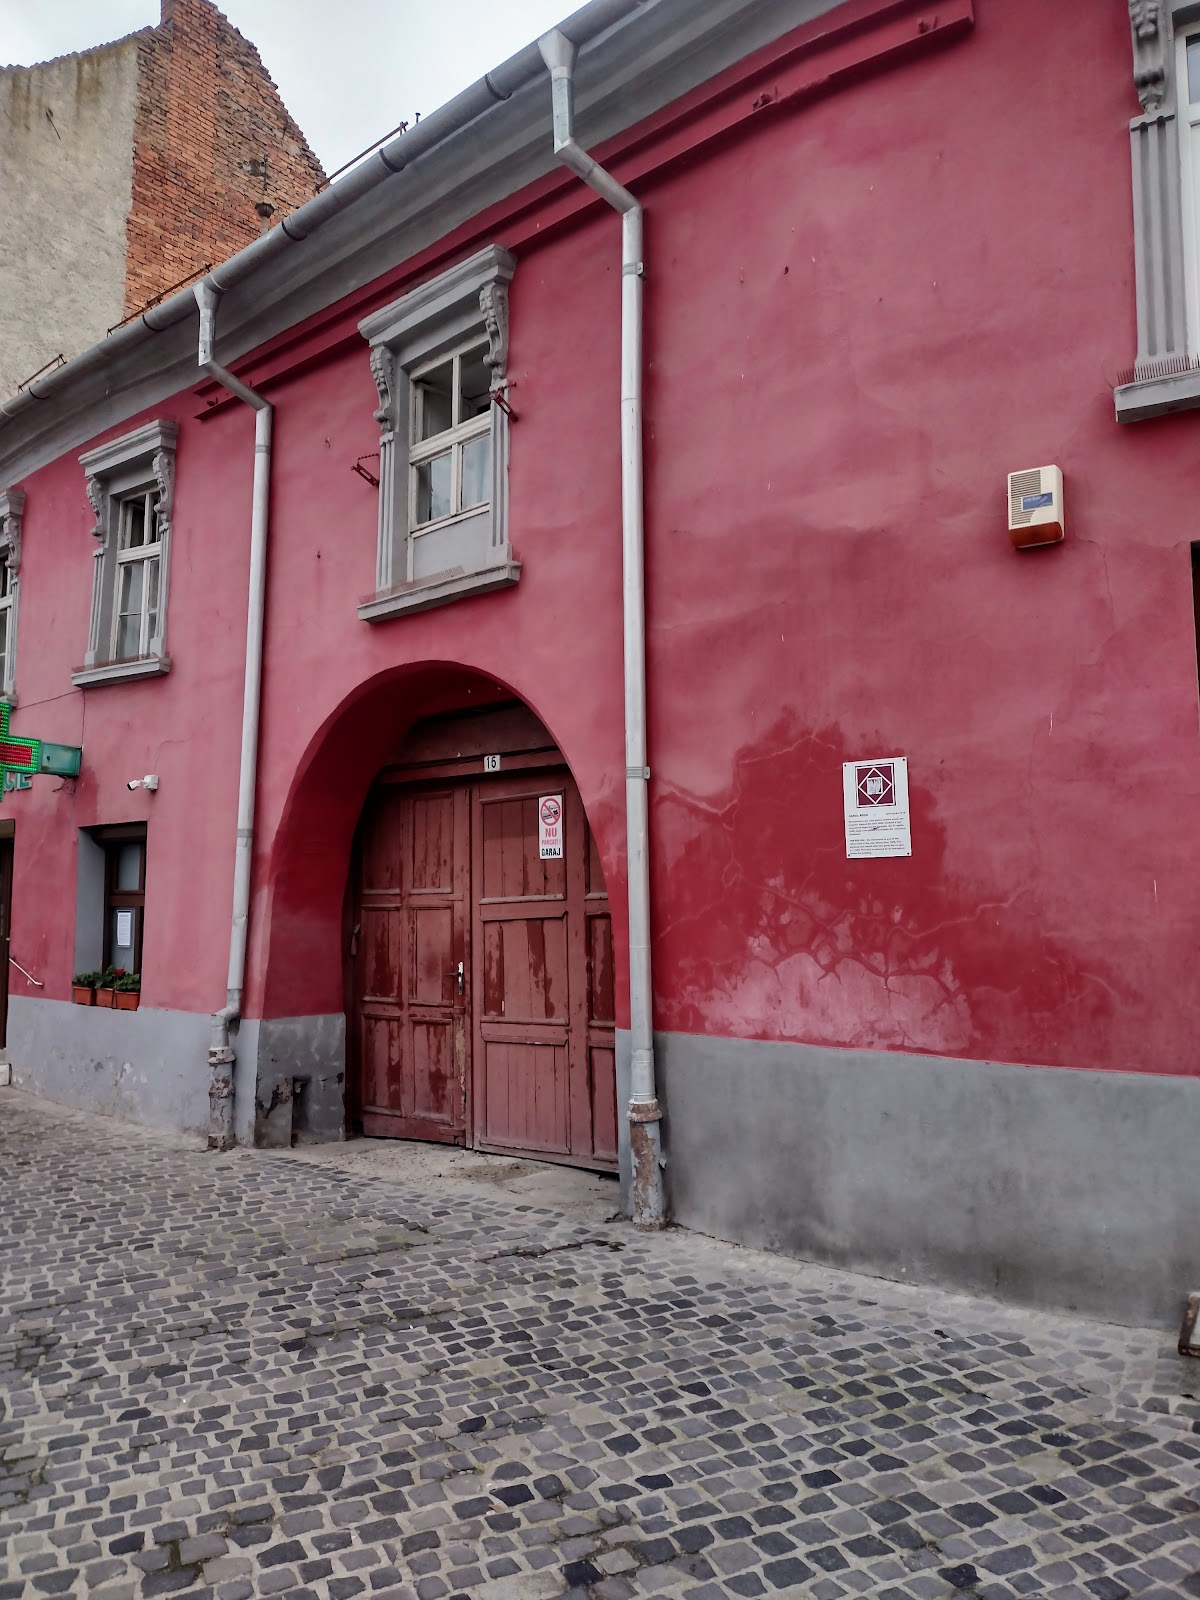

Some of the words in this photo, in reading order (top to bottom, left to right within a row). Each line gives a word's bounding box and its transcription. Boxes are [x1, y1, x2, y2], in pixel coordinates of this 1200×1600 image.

[487, 756, 497, 769] 16
[545, 827, 557, 838] NU
[541, 847, 561, 857] GARAJ
